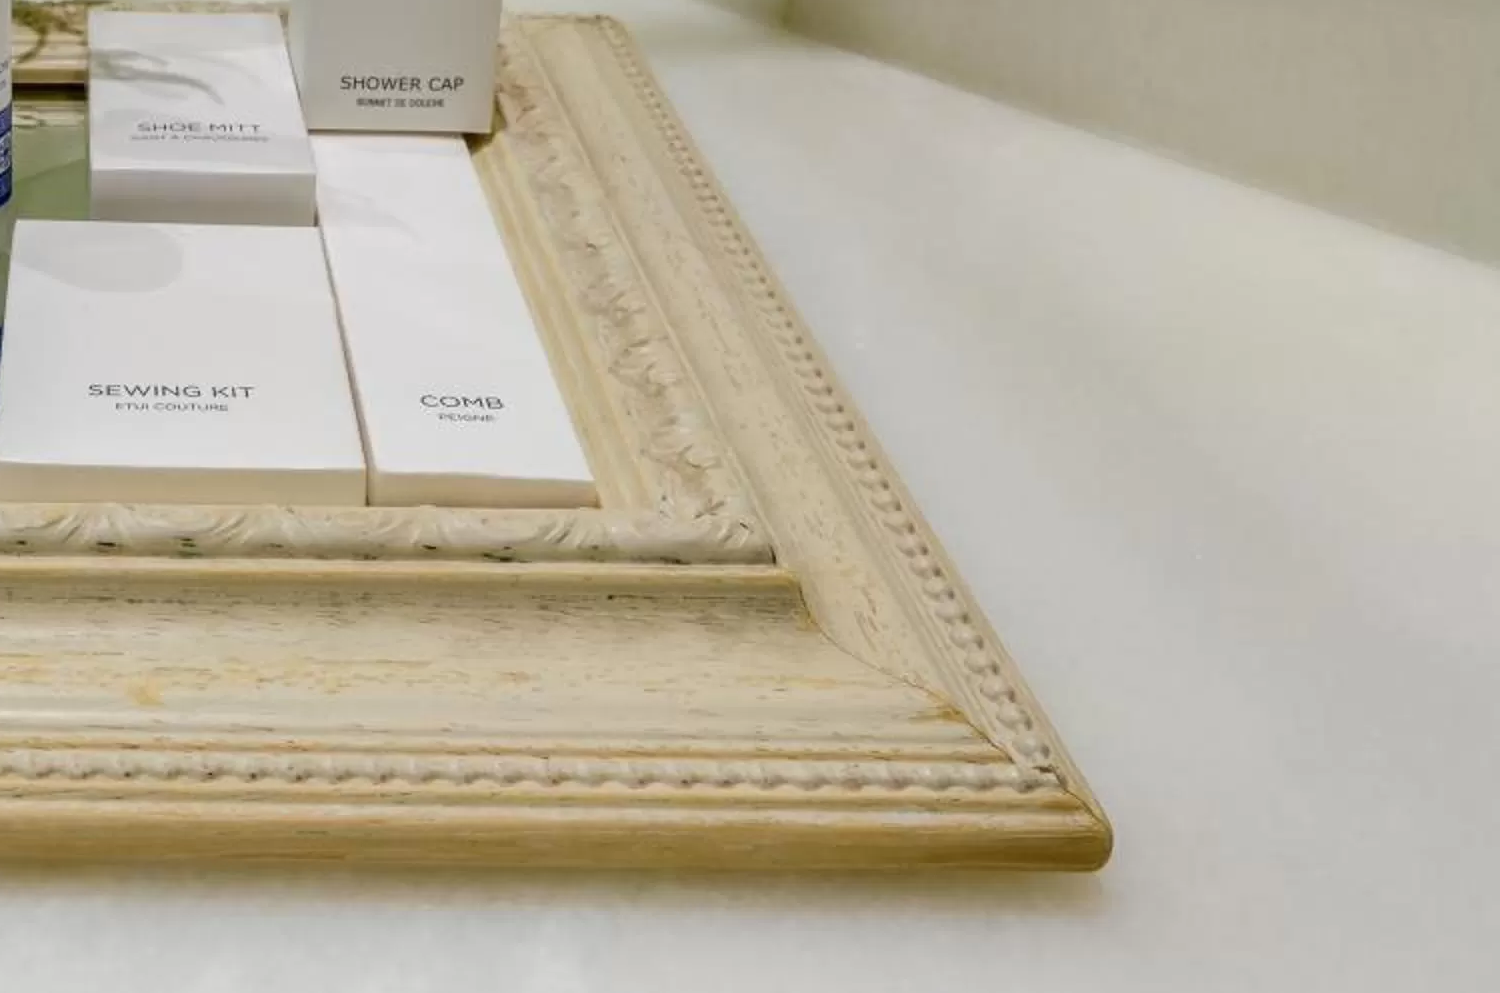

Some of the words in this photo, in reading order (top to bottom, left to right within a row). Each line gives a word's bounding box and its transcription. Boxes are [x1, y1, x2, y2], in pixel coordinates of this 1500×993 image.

[340, 75, 422, 92] SHOWER
[428, 75, 465, 92] CAP
[137, 122, 201, 132] SHOE
[208, 122, 261, 132] MITT
[88, 384, 203, 398] SEWING
[211, 386, 255, 399] KIT
[115, 402, 150, 412] ETUI
[153, 402, 229, 413] COUTURE
[420, 394, 505, 410] COMB
